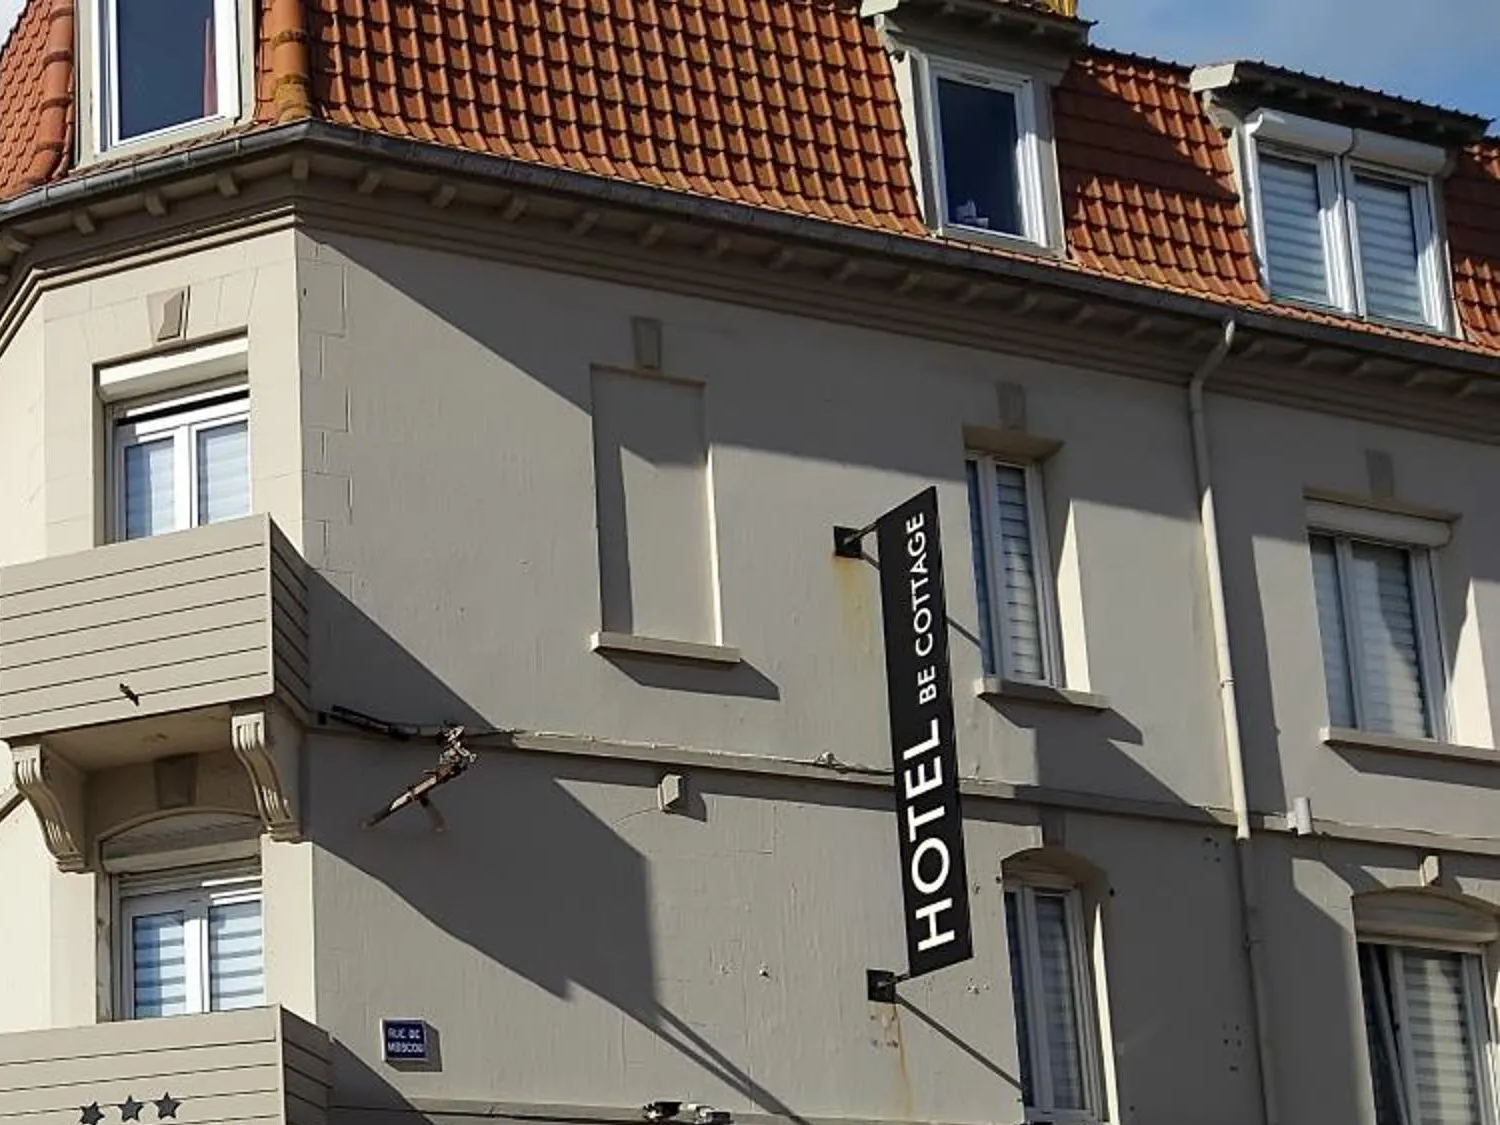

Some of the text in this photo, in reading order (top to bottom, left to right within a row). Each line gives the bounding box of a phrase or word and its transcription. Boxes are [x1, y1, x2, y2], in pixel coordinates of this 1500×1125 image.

[903, 511, 955, 951] HOTEL BE COTTAGE
